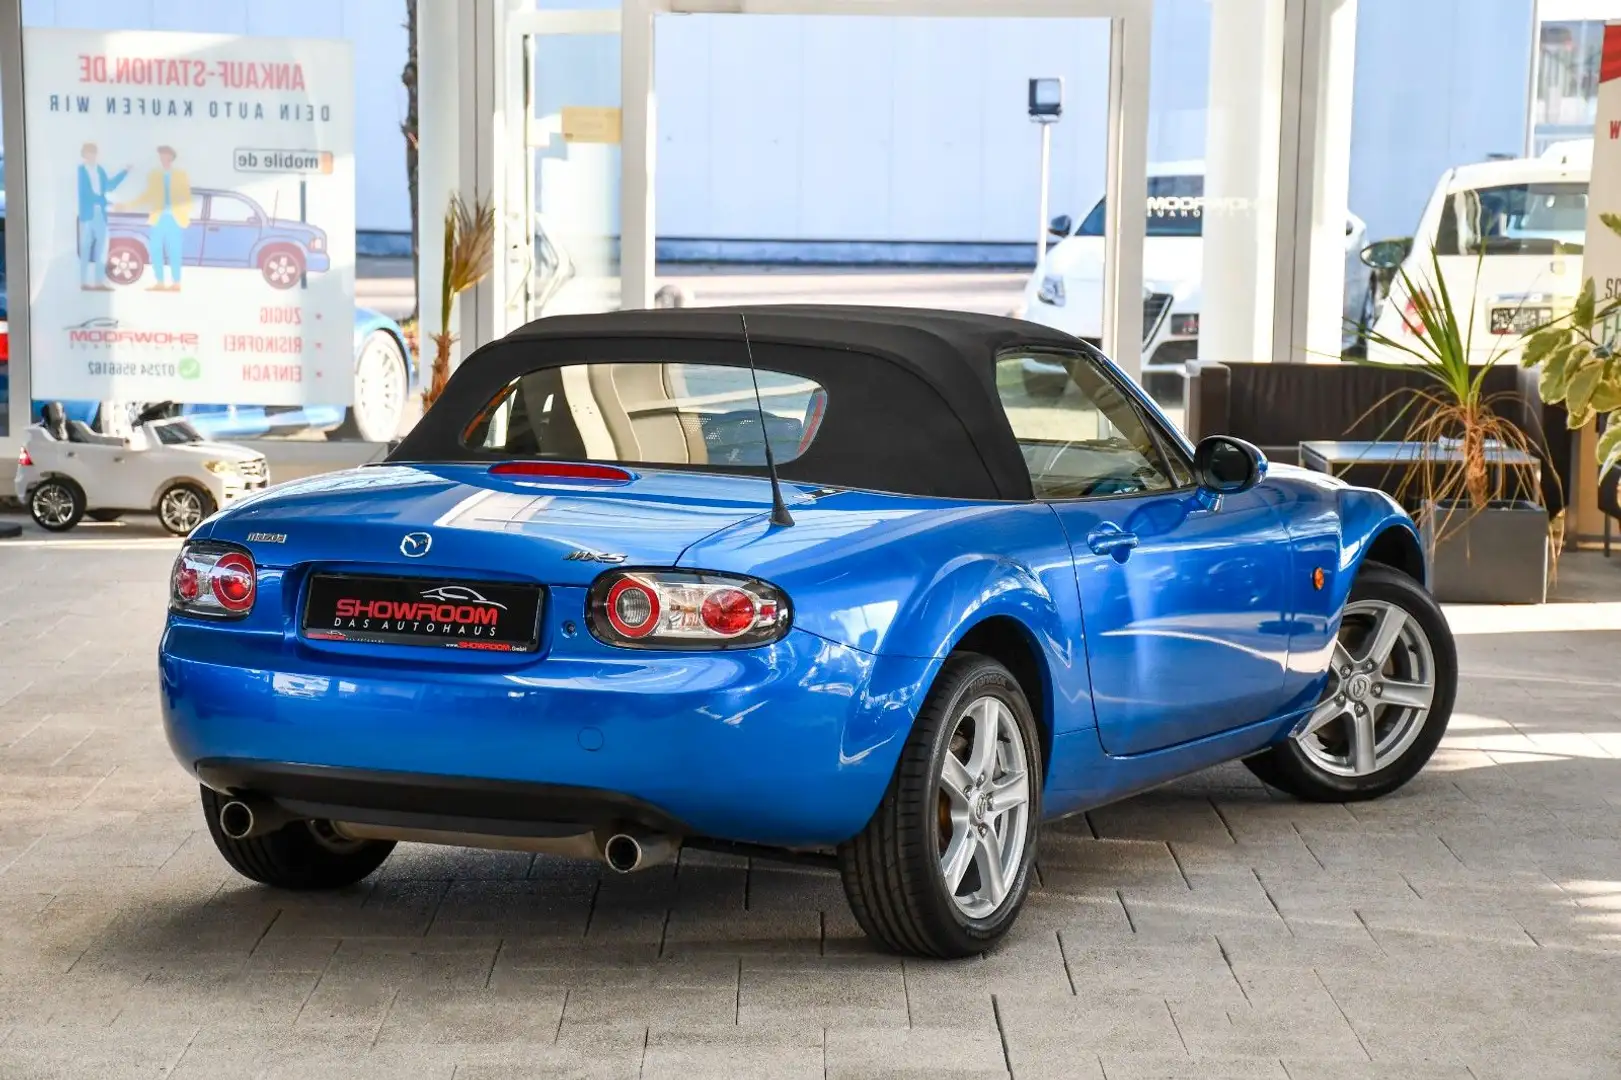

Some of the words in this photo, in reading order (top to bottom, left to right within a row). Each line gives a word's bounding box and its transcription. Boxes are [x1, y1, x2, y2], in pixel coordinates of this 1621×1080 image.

[335, 598, 499, 626] SHOWROOM
[334, 617, 370, 629] DAS
[381, 622, 496, 637] AUTOHAUS
